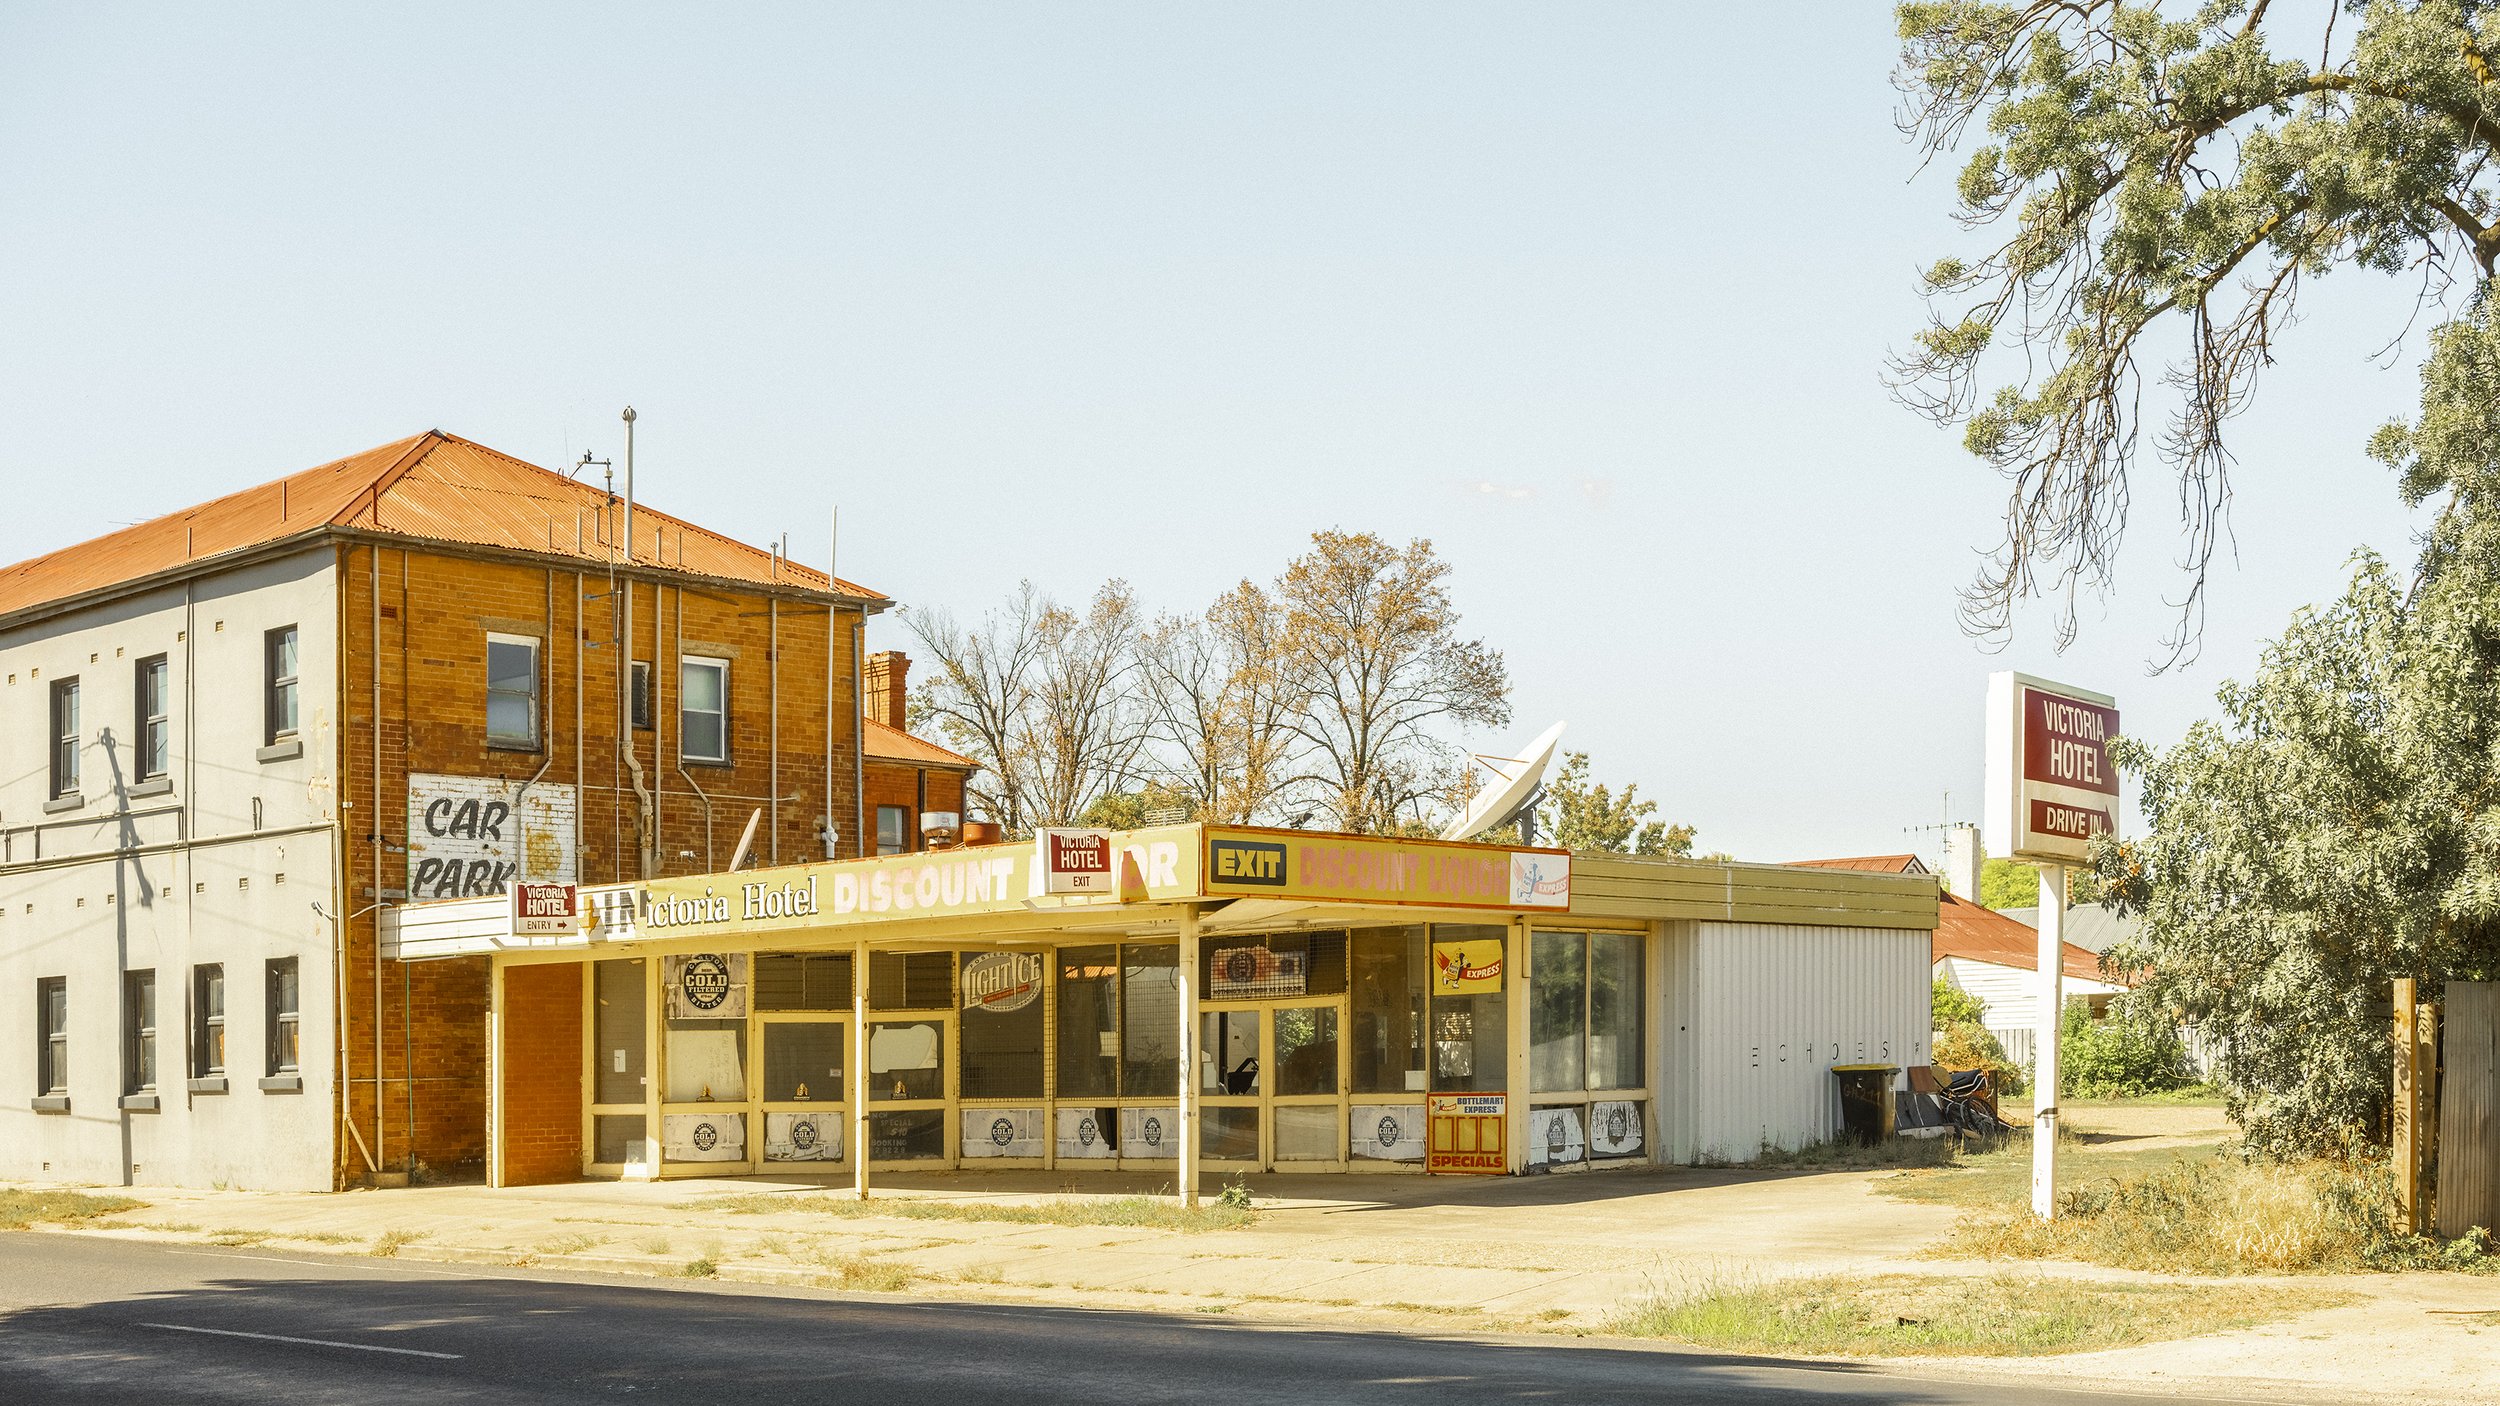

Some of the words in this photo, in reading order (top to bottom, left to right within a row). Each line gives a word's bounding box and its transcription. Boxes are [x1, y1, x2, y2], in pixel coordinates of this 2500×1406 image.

[2043, 700, 2106, 743] VICTORIA
[2050, 738, 2102, 785] HOTEL
[424, 797, 510, 842] CAR
[2046, 806, 2086, 835] DRIVE
[1060, 834, 1101, 849] VICTORIA
[1060, 850, 1102, 869] HOTEL
[1217, 848, 1281, 878] EXIT
[411, 857, 516, 898] PARK
[1300, 846, 1420, 893] DISCOUNT
[1429, 855, 1509, 900] LIQUOR
[834, 856, 1014, 914] DISCOUNT
[1073, 876, 1090, 887] EXIT
[526, 887, 568, 899] VICTORIA
[646, 885, 730, 928] ictoria
[742, 873, 819, 920] Hotel
[526, 899, 569, 916] HOTEL
[527, 920, 551, 930] ENTRY
[970, 952, 1012, 968] FOSTER'S
[1466, 963, 1500, 978] EXPRESS
[685, 974, 728, 987] COLD
[962, 961, 1011, 1009] LIGHT
[691, 996, 722, 1009] BITTER
[1457, 1097, 1505, 1105] BOTTLEMART
[1464, 1106, 1497, 1114] EXPRESS
[880, 1119, 913, 1127] SPECIAL
[1378, 1127, 1397, 1135] COLD
[1431, 1156, 1504, 1168] SPECIALS
